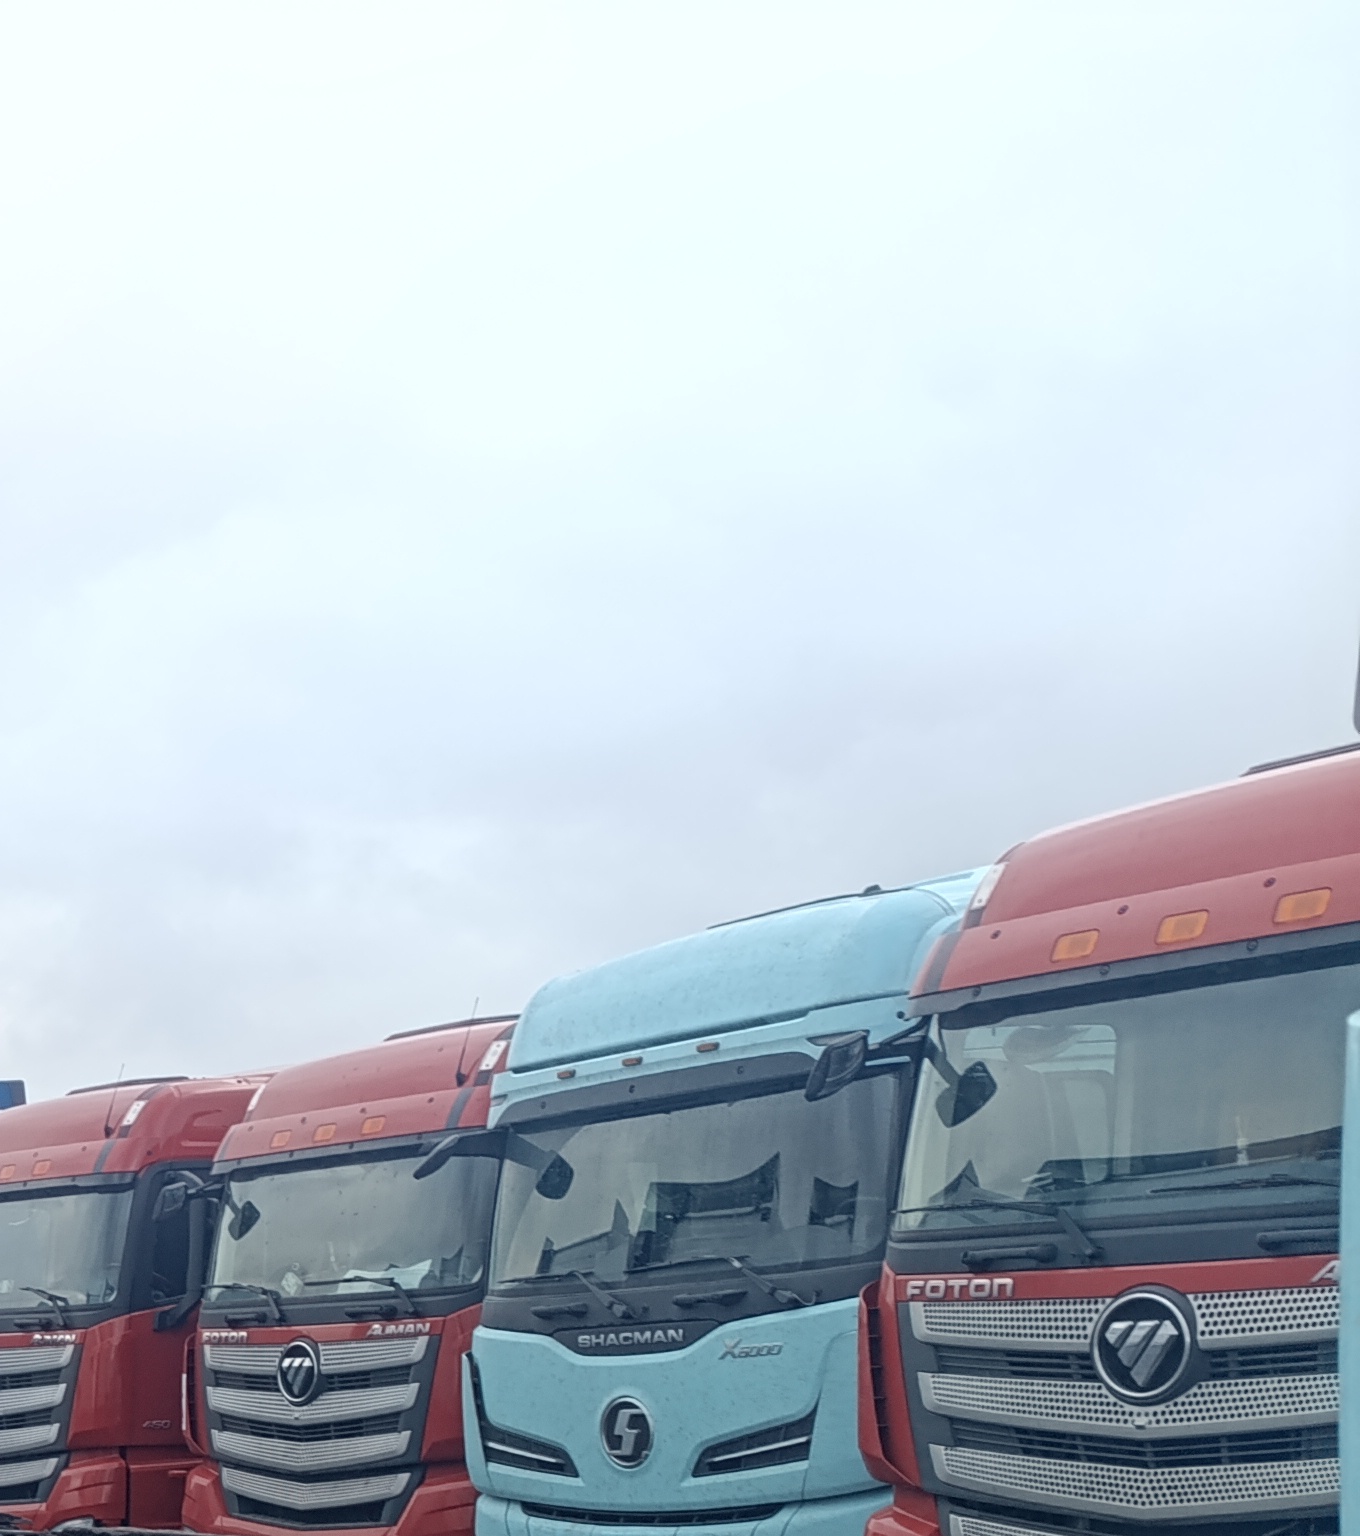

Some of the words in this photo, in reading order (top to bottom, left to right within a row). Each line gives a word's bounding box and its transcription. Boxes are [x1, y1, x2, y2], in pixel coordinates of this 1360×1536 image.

[906, 1278, 1014, 1300] FOTON
[202, 1331, 248, 1344] FOTON
[577, 1329, 684, 1349] SHACMAN
